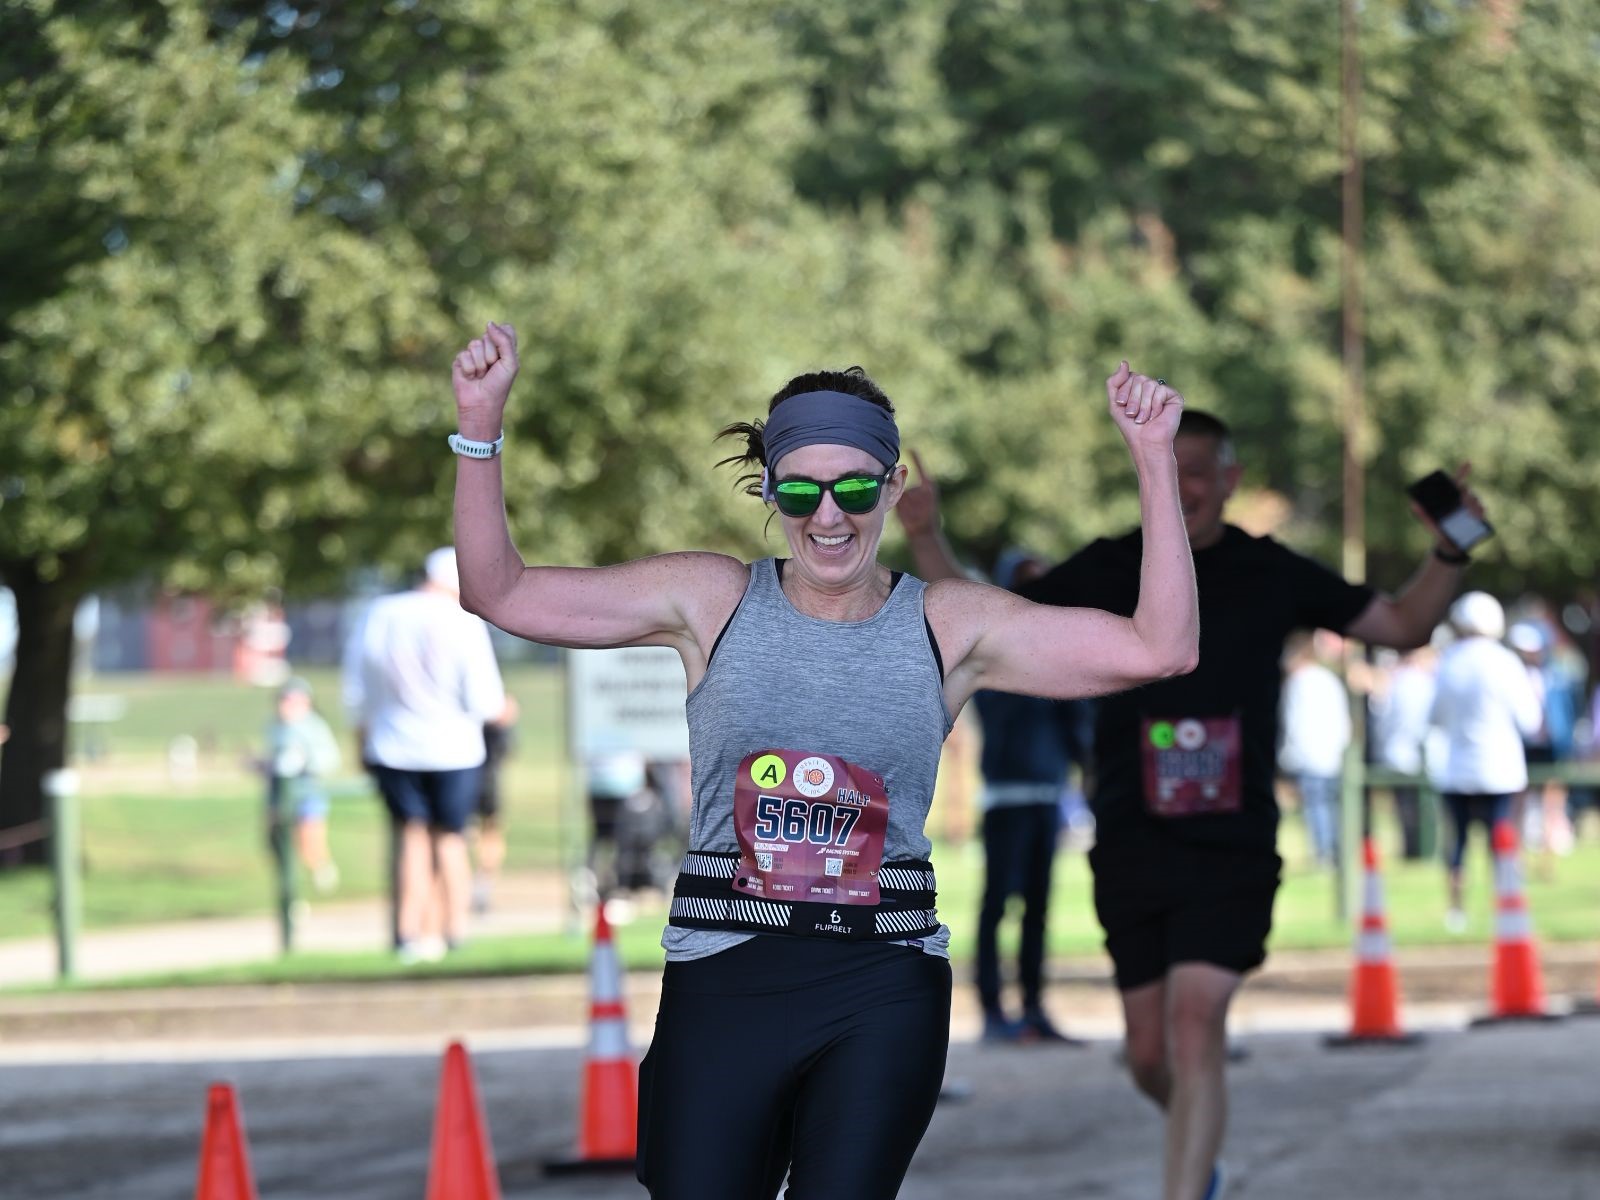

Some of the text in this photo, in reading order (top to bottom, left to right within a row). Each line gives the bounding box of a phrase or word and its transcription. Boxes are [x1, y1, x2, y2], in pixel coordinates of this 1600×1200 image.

[760, 764, 778, 784] A
[837, 788, 871, 806] HALF
[755, 795, 861, 846] 5607
[815, 923, 852, 934] FLIPBELT
